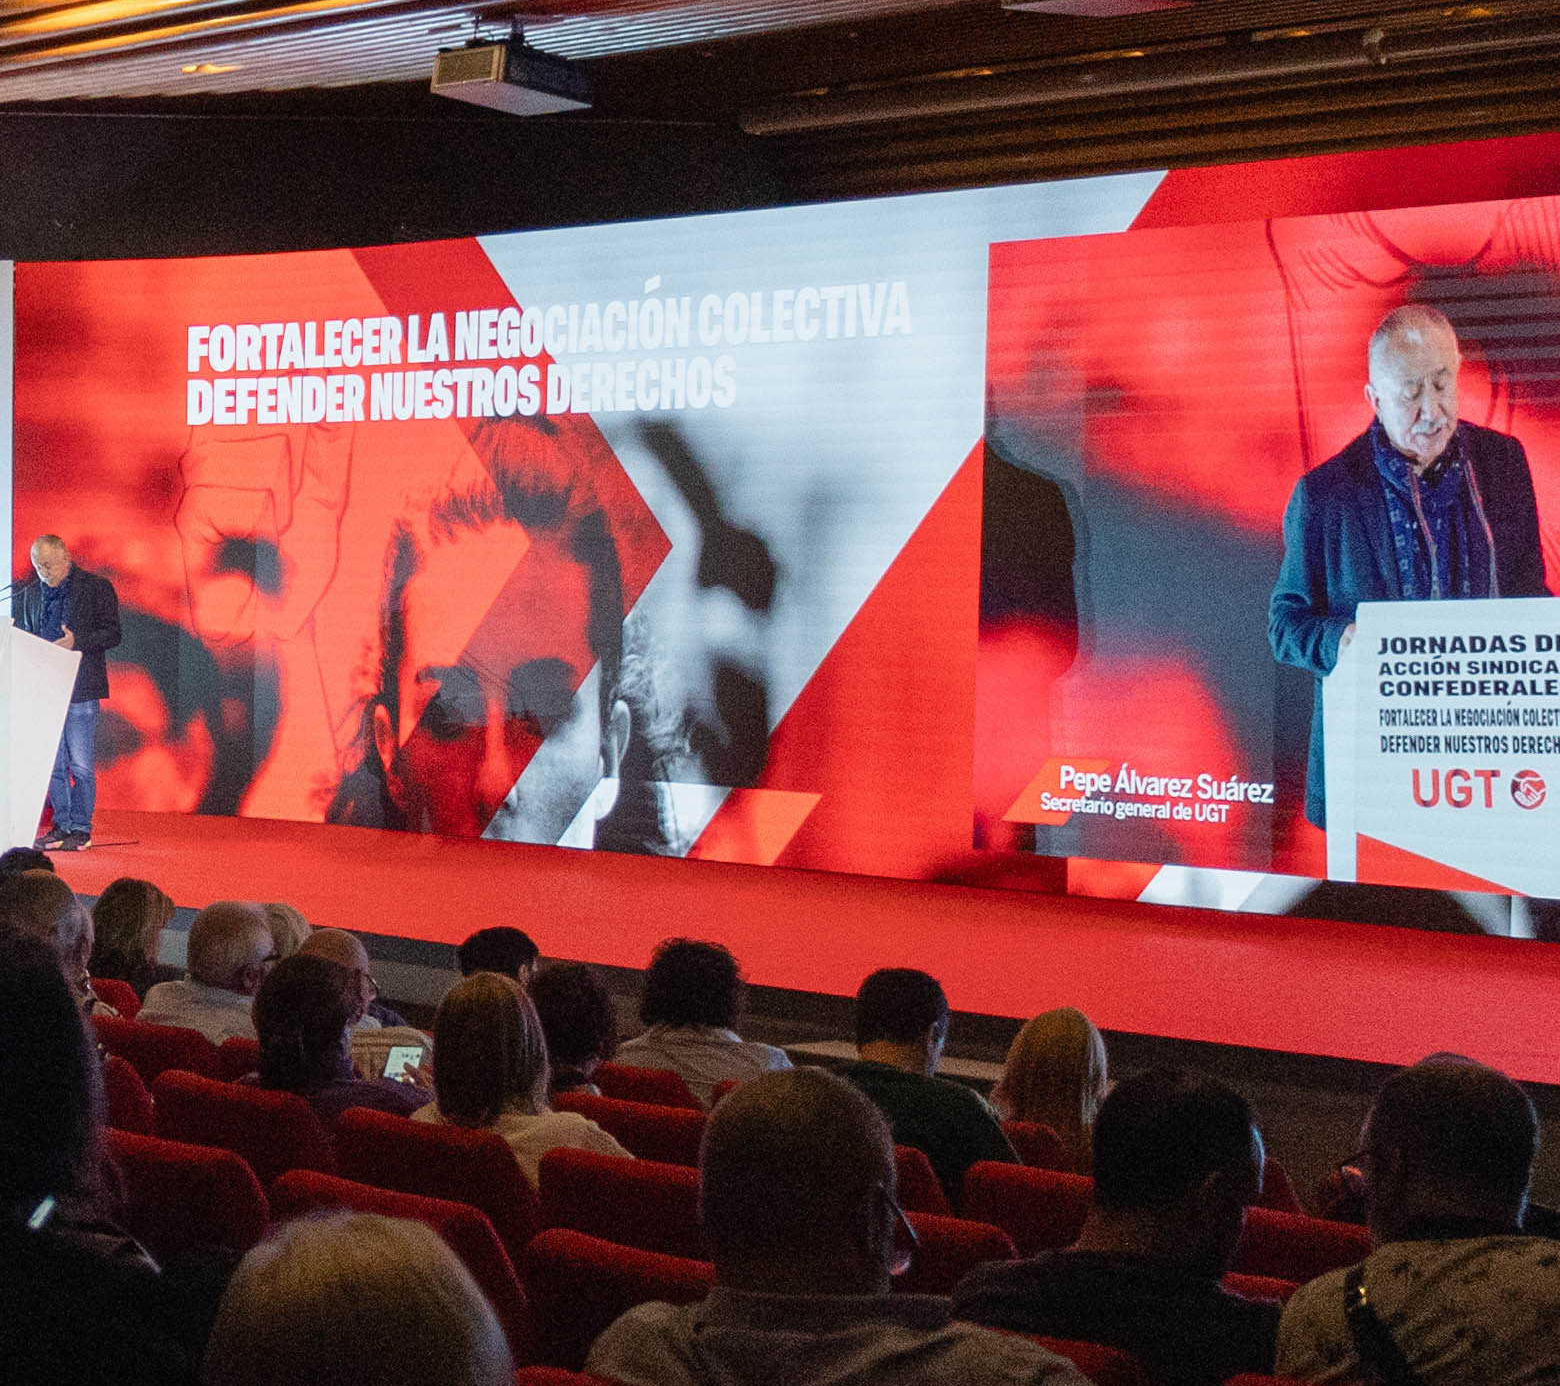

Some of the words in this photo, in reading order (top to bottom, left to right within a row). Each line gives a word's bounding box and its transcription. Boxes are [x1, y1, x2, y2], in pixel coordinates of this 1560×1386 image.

[187, 316, 403, 372] FORTALECER
[408, 312, 450, 363] LA
[455, 274, 691, 360] NEGOCIACIÓN
[698, 281, 912, 347] COLECTIVA
[186, 375, 365, 426] DEFENDER
[370, 364, 541, 421] NUESTROS
[546, 355, 736, 415] DERECHOS
[1377, 634, 1526, 655] JORNADAS
[1379, 655, 1460, 676] ACCIÓN
[1379, 709, 1438, 727] FORTALECER
[1440, 709, 1452, 727] LA
[1454, 700, 1520, 727] NEGOCIACIÓN
[1380, 735, 1440, 753] DEFENDER
[1444, 735, 1509, 754] NUESTROS
[1060, 765, 1111, 797] Pepe
[1114, 763, 1193, 797] Álvarez
[1196, 773, 1274, 804] Suárez
[1412, 769, 1501, 808] UGT
[1040, 792, 1114, 815] Secretario
[1115, 800, 1170, 820] general
[1173, 803, 1192, 820] de
[1194, 803, 1229, 822] UGT
